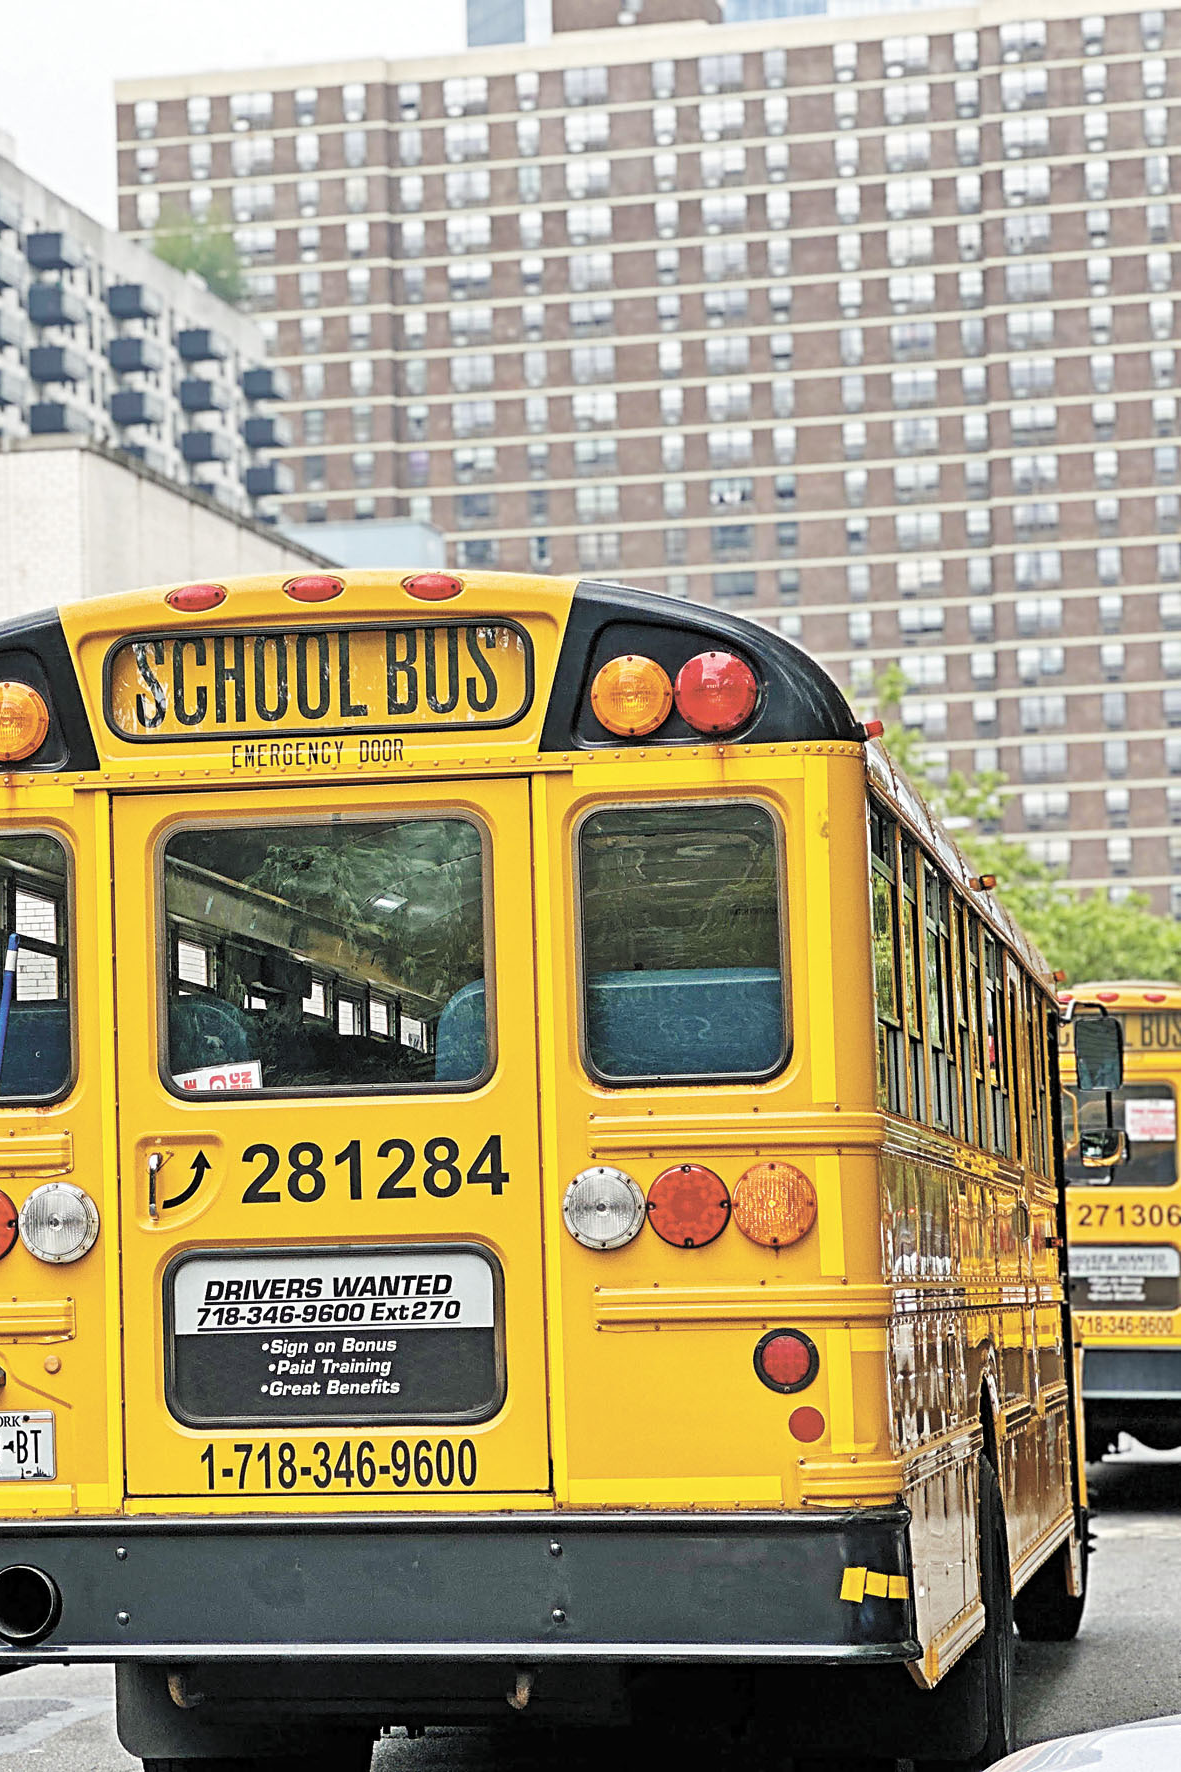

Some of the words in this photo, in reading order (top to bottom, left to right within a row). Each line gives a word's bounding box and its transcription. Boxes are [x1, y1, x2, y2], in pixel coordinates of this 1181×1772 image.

[135, 631, 368, 728] SCHOOL
[385, 626, 499, 715] BUS
[231, 742, 345, 768] EMERGENCY
[359, 738, 405, 762] DOOR
[241, 1134, 510, 1204] 281284
[1078, 1204, 1181, 1227] 271306
[205, 1278, 323, 1301] DRIVERS
[332, 1274, 453, 1298] WANTED
[197, 1302, 365, 1327] 718-346-9600
[370, 1300, 461, 1322] Ext270
[270, 1340, 308, 1356] Sign
[314, 1342, 336, 1354] on
[342, 1338, 397, 1353] Bonus
[276, 1360, 315, 1375] Paid
[321, 1358, 392, 1376] Training
[269, 1380, 321, 1397] Great
[326, 1379, 401, 1396] Benefits
[16, 1429, 42, 1465] BT
[200, 1439, 477, 1491] 1-718-346-9600
